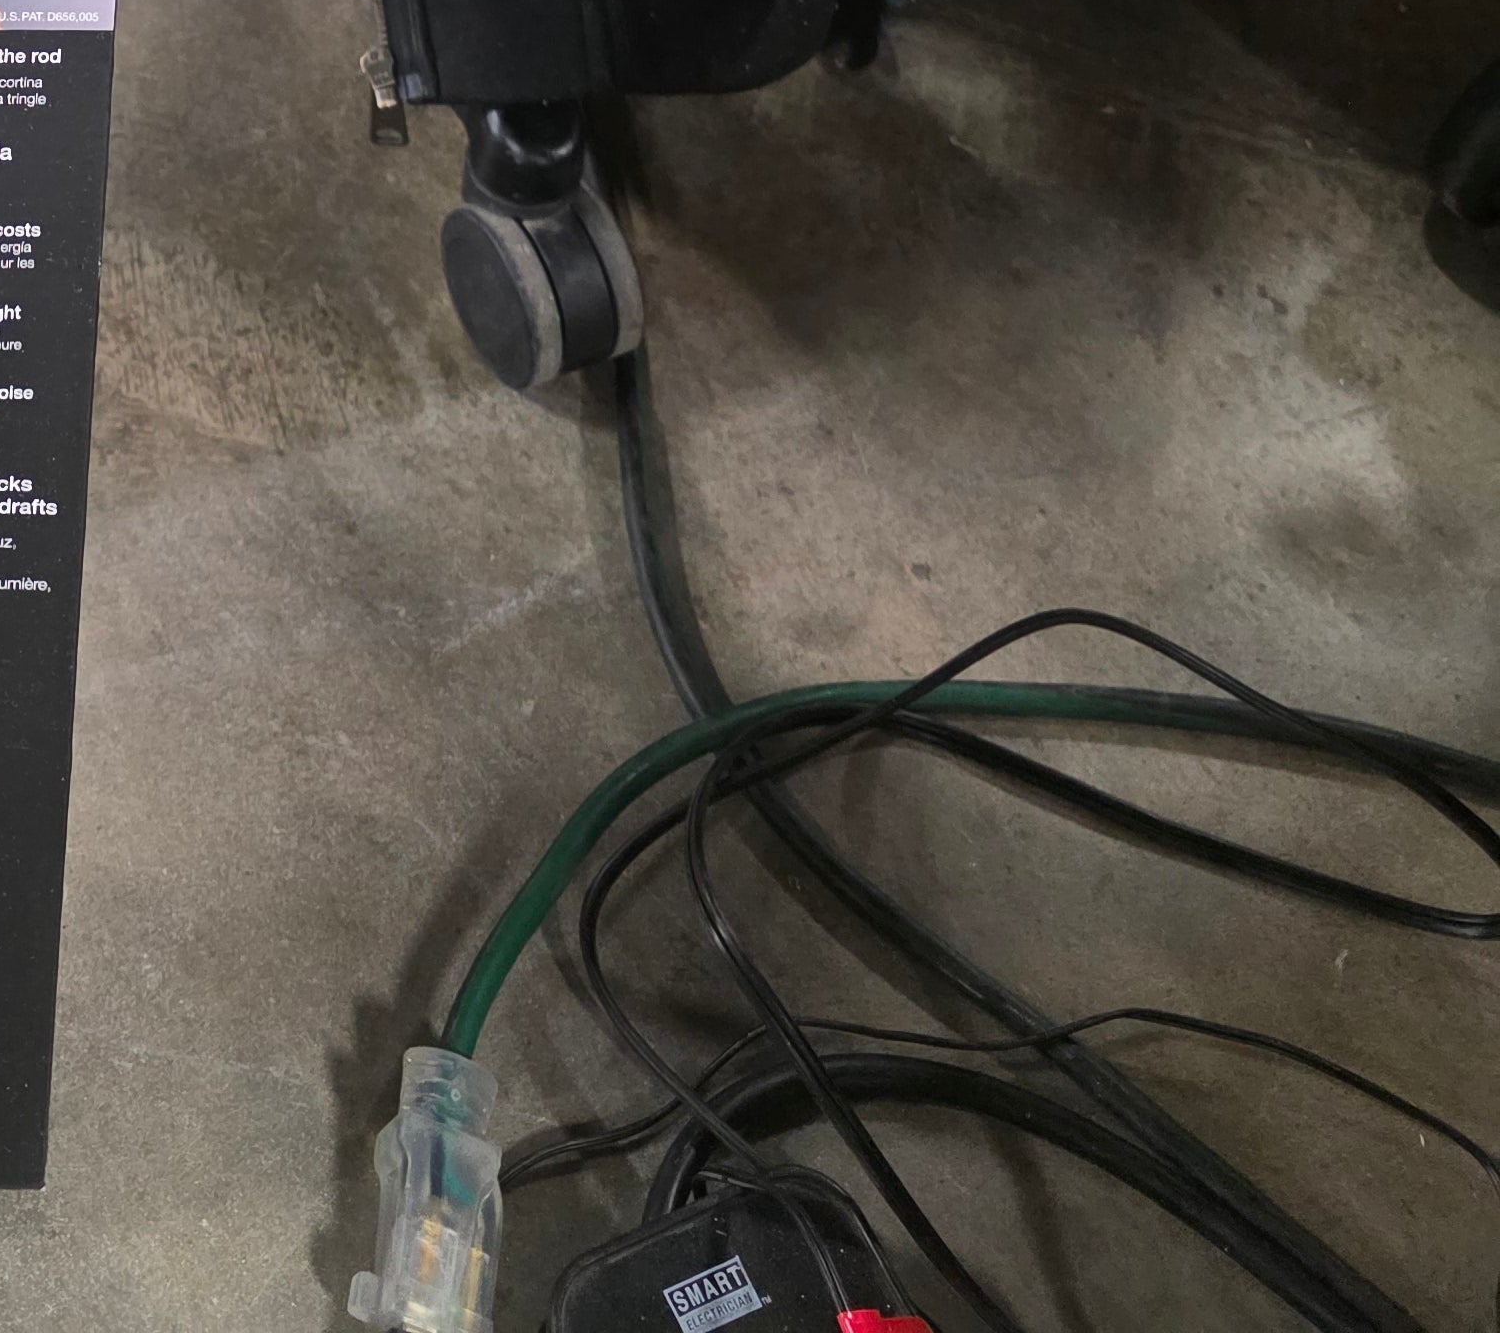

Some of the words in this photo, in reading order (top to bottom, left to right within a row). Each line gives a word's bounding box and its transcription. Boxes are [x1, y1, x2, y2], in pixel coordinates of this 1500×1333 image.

[31, 49, 61, 63] rod
[0, 77, 42, 88] cortina
[7, 93, 46, 107] tringle
[17, 257, 34, 268] les
[673, 1265, 742, 1312] SMART
[686, 1293, 753, 1330] ELECTRICIAN
